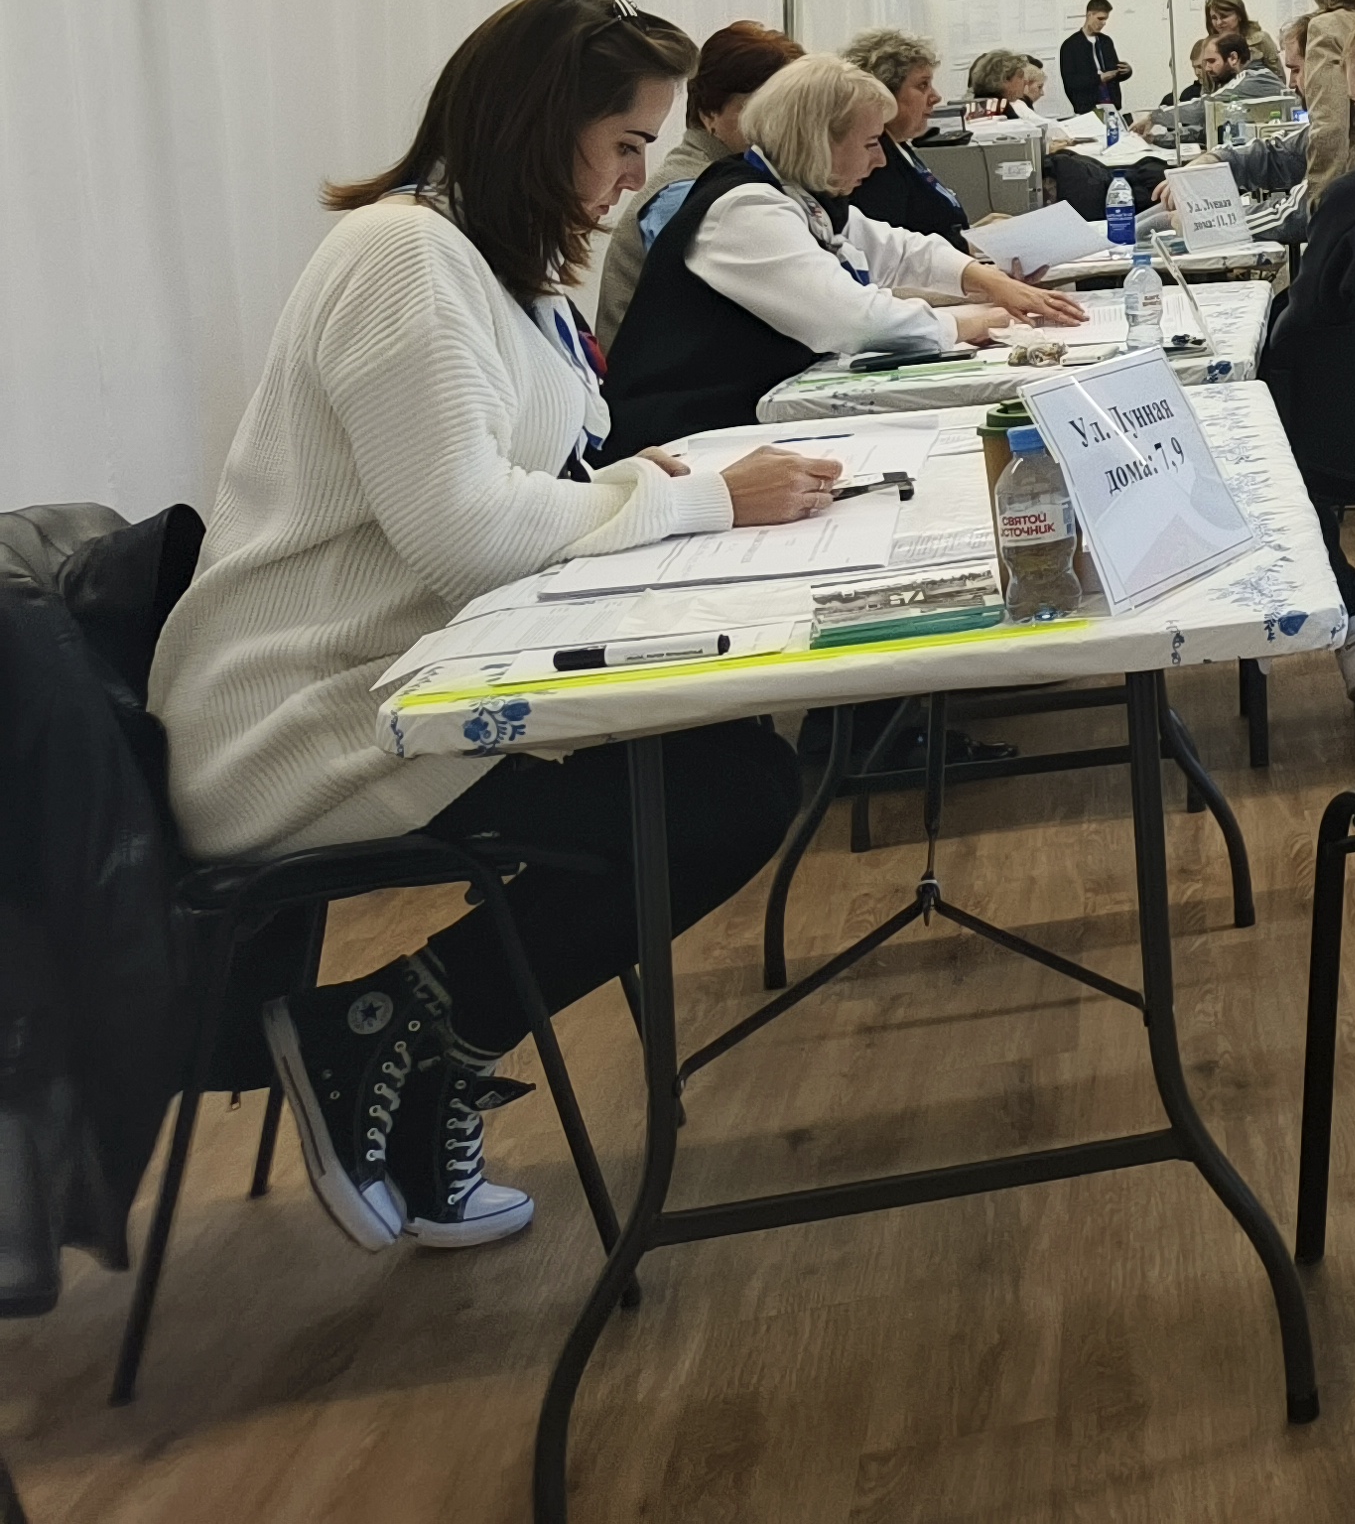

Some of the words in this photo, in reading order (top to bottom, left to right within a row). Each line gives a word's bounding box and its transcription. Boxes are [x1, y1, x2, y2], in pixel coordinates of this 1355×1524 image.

[1068, 416, 1112, 448] Ул.
[1107, 398, 1175, 439] Лунная
[1104, 454, 1159, 495] дома:
[1153, 436, 1185, 474] 7,9
[1001, 510, 1047, 527] СВЯТОЙ
